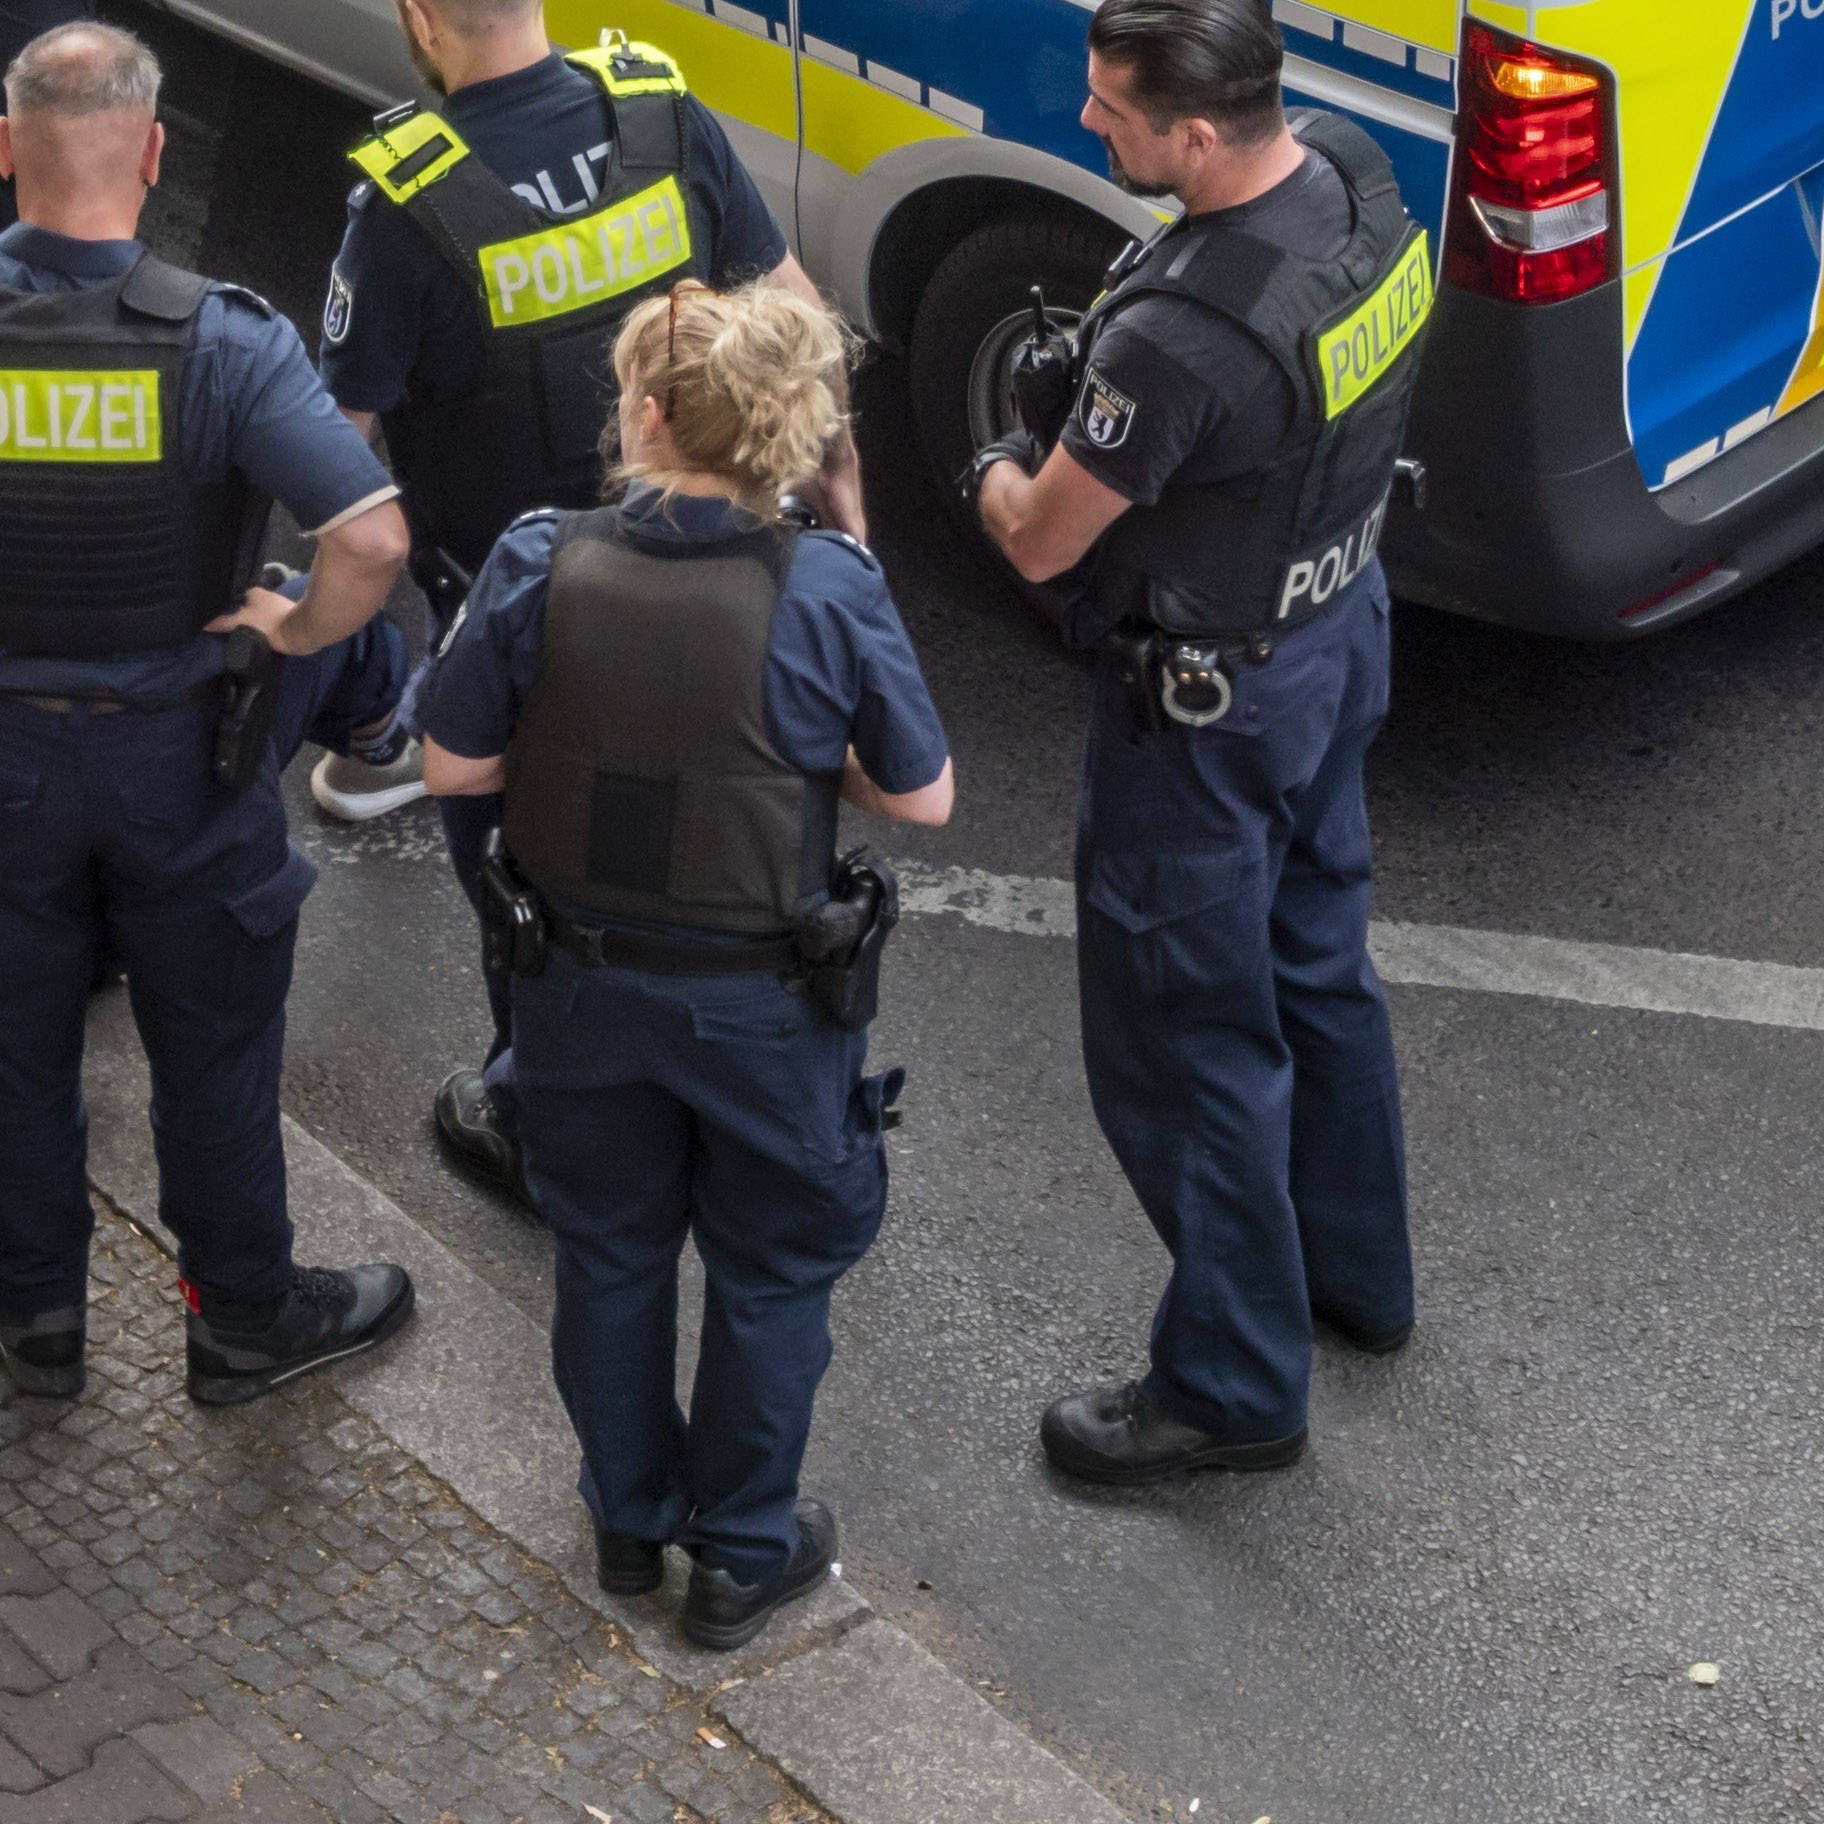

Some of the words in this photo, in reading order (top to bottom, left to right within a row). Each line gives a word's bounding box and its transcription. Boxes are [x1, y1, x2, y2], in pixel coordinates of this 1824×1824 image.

[493, 194, 683, 315] POLIZEI
[1329, 250, 1427, 401] POLIZEI
[1089, 373, 1131, 415] POLIZEI
